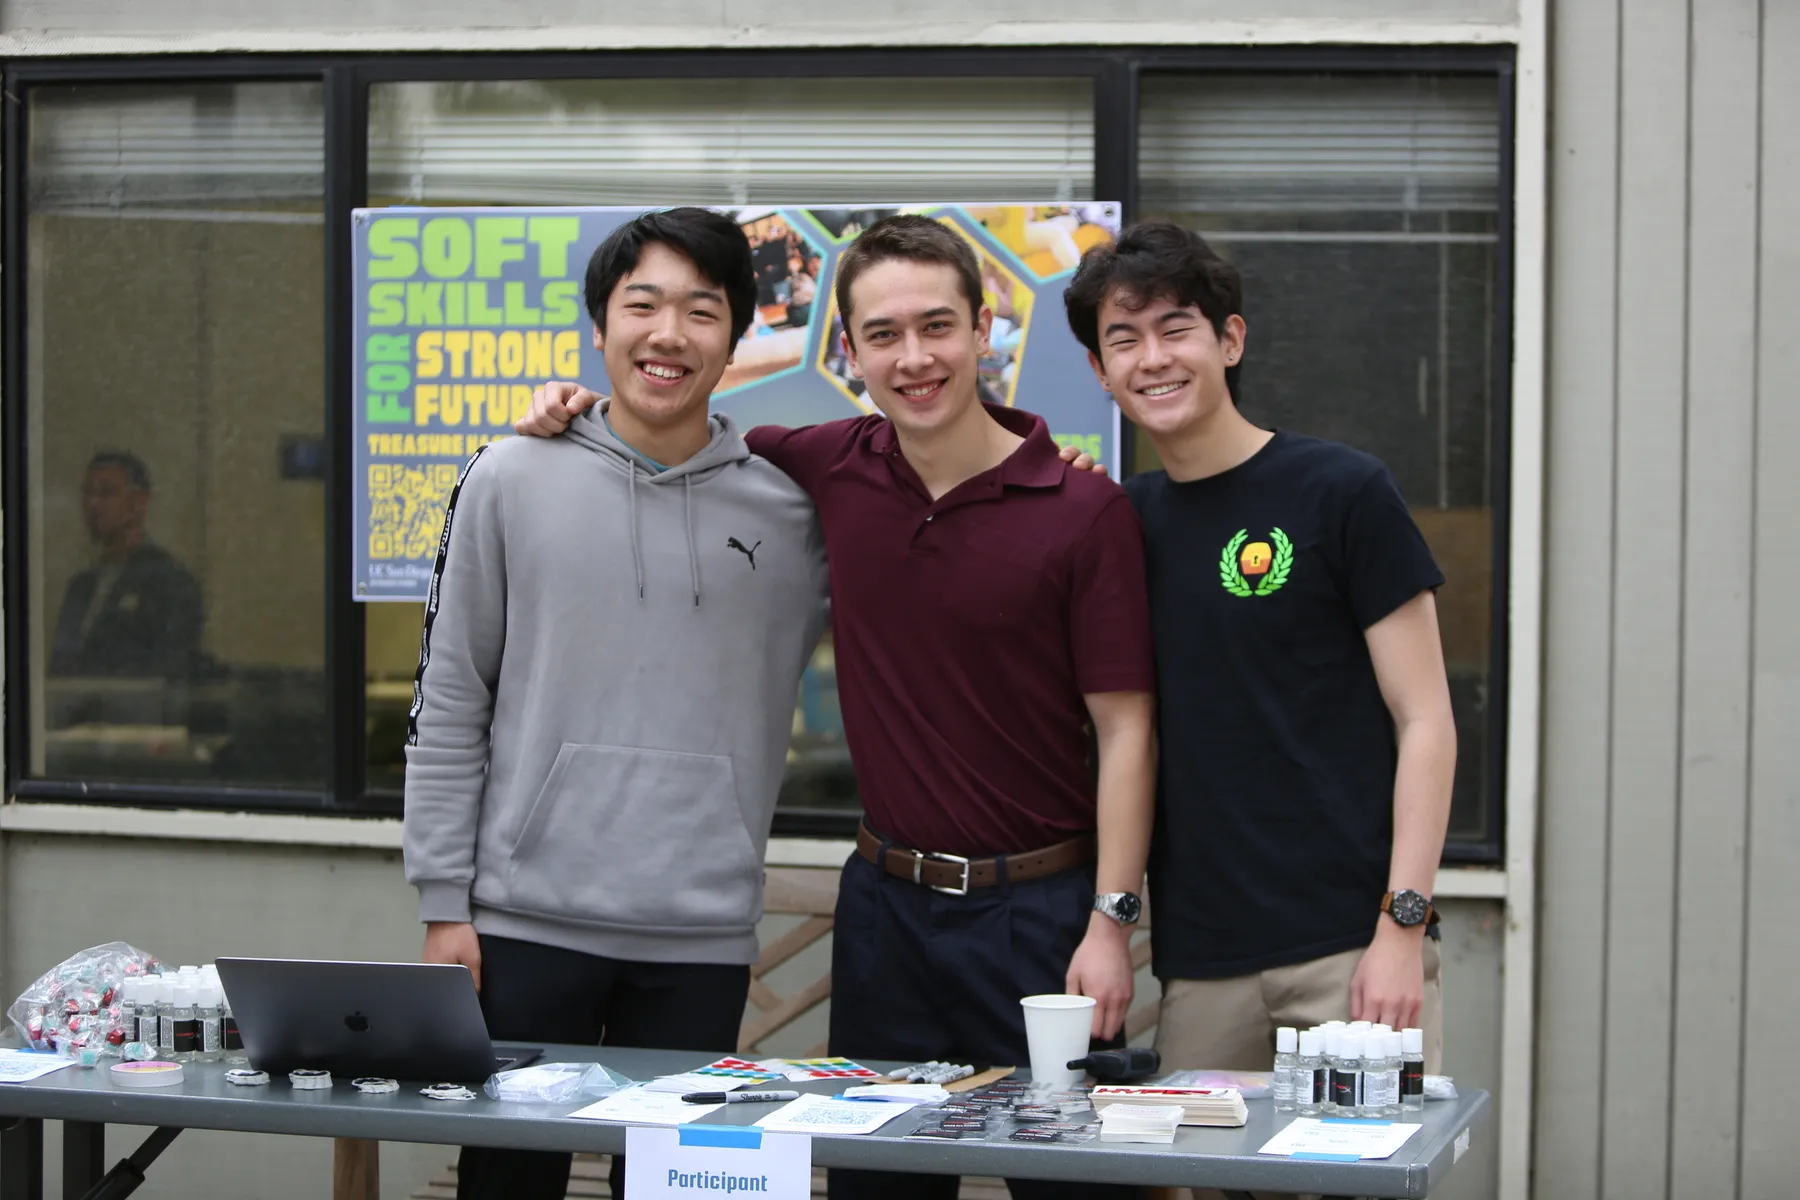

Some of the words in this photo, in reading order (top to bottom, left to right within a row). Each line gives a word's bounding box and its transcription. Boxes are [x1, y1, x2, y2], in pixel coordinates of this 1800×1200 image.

[367, 217, 580, 279] SOFT
[367, 281, 579, 326] SKILLS
[416, 331, 580, 378] STRONG
[366, 333, 411, 423] FOR
[415, 384, 545, 426] FUTUR
[367, 433, 464, 456] TREASURE
[668, 1169, 768, 1194] Participant
